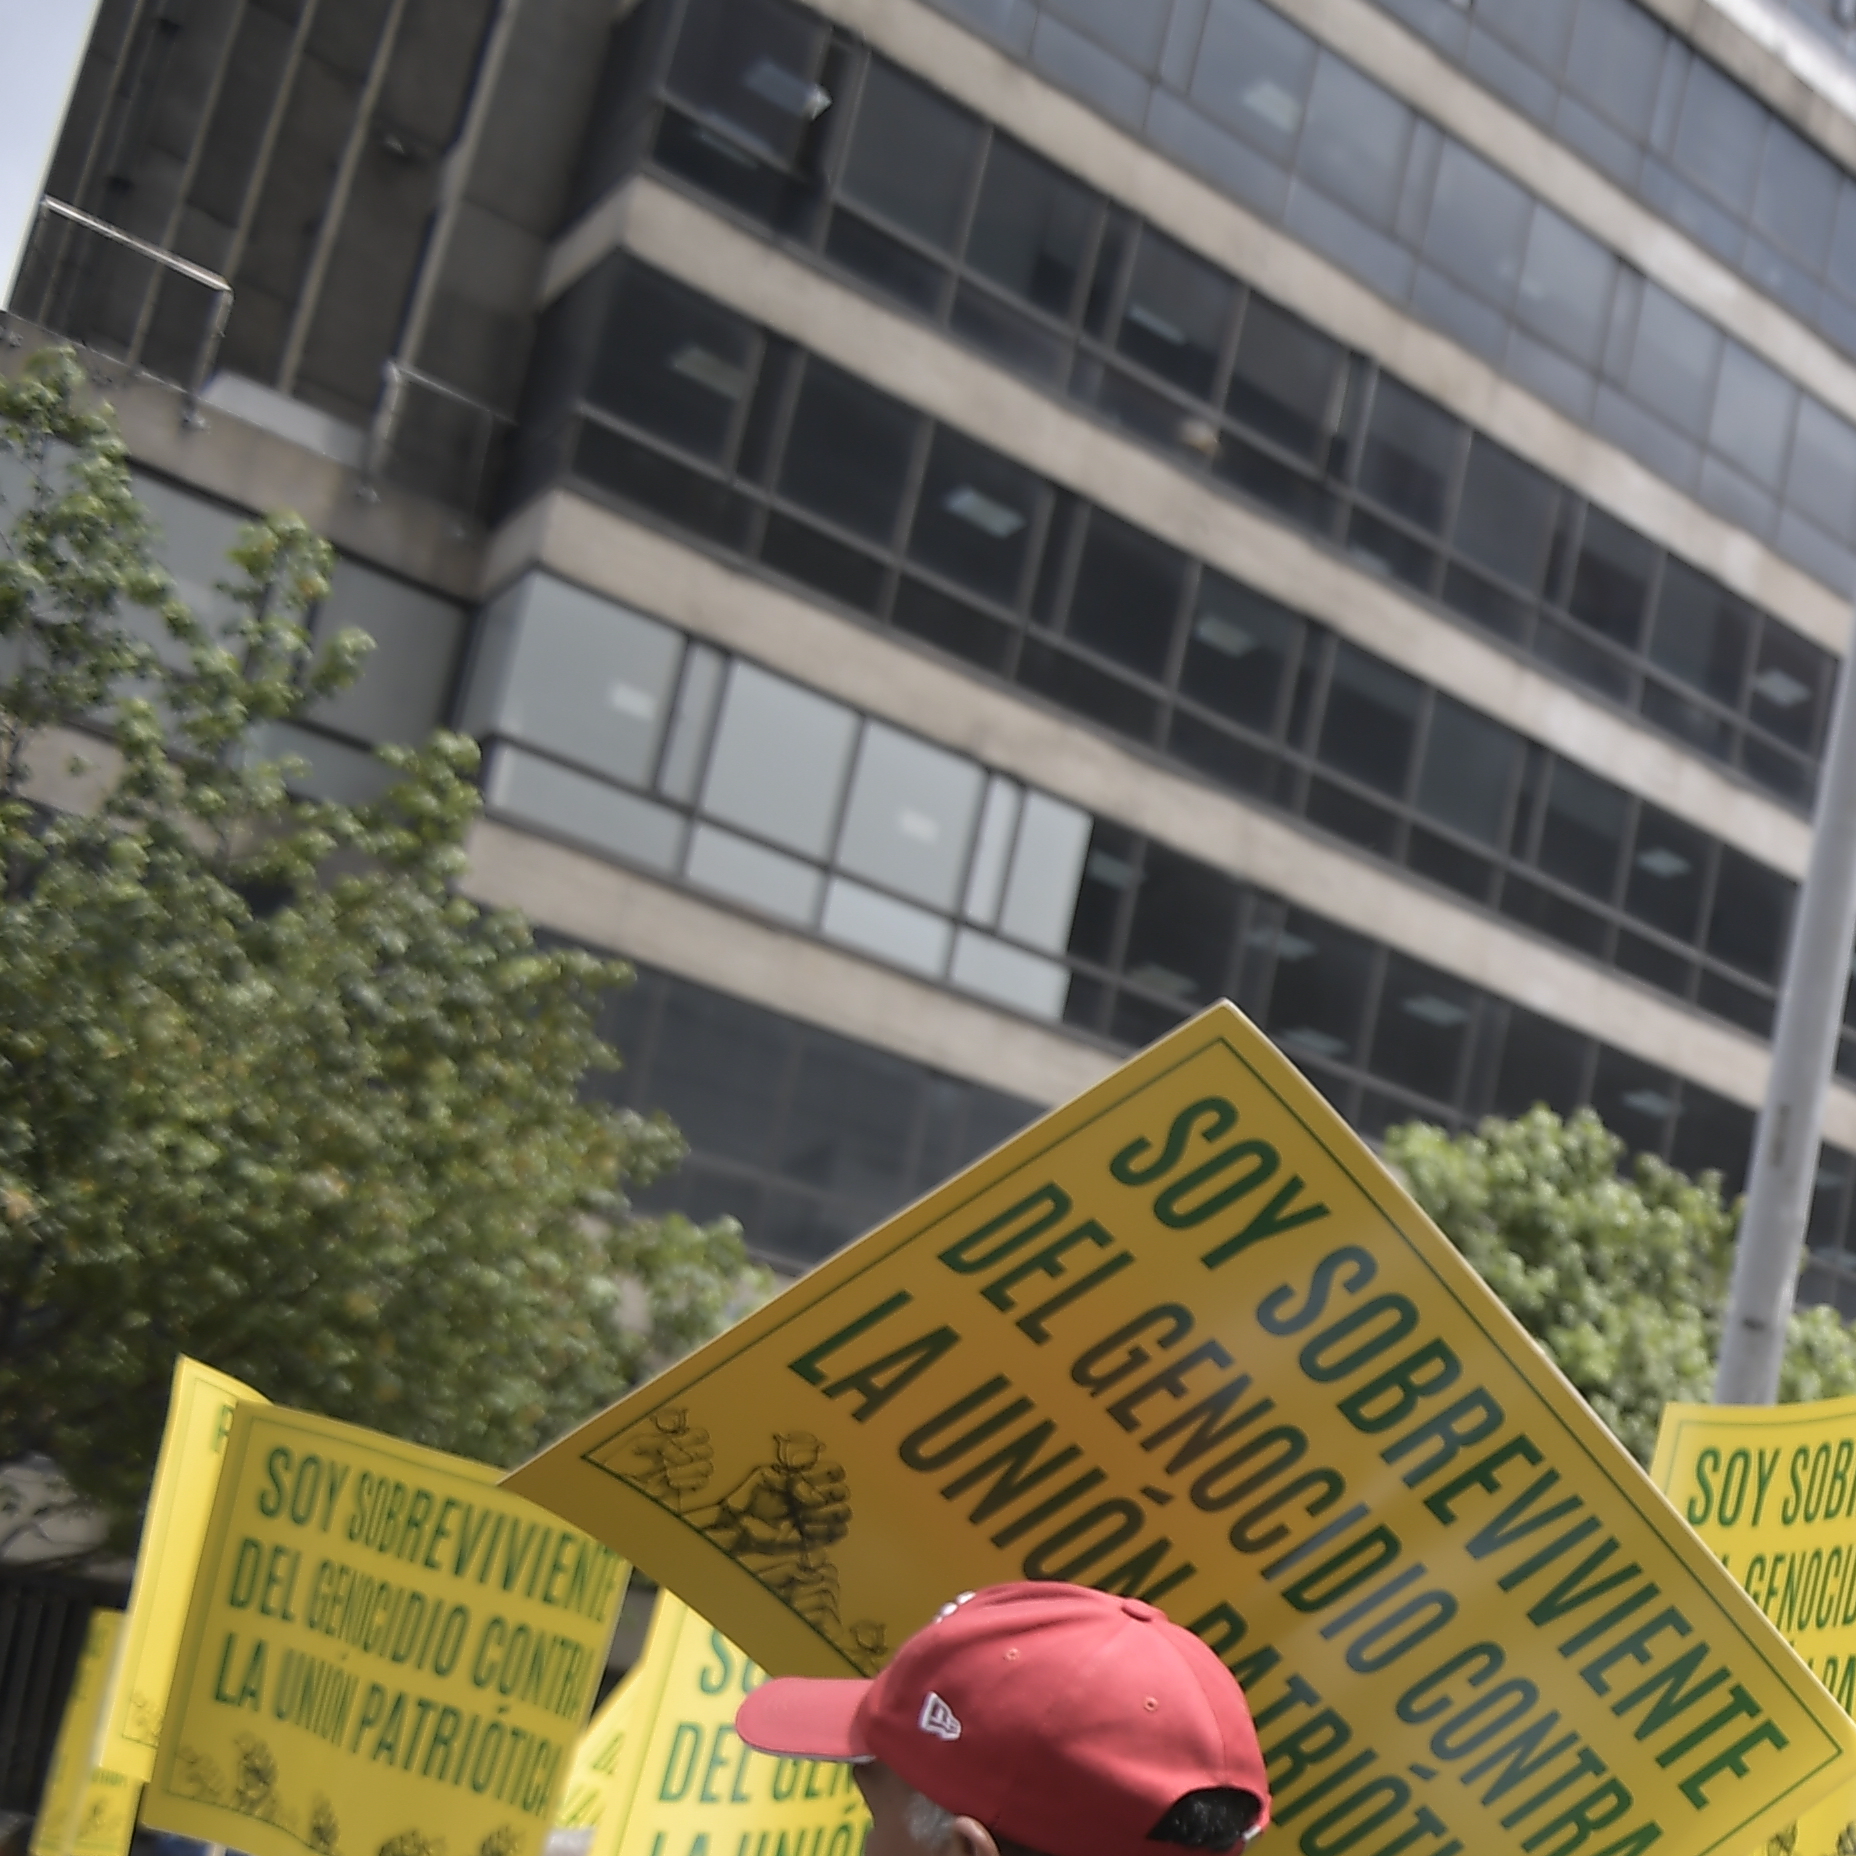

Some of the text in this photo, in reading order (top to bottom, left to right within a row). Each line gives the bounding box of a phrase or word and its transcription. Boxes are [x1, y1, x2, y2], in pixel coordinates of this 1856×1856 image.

[259, 1446, 352, 1533] SOY
[788, 1289, 959, 1422] LA
[898, 1372, 1198, 1606] UNIÓN
[937, 1184, 1137, 1348] DEL
[1069, 1300, 1406, 1675] GENOCIDIO
[1108, 1094, 1788, 1812] SOY SOBREVIVIENTE
[1687, 1446, 1781, 1527] SOY
[213, 1633, 270, 1714] LA
[229, 1538, 303, 1622] DEL
[308, 1558, 473, 1679] GENOCIDIO
